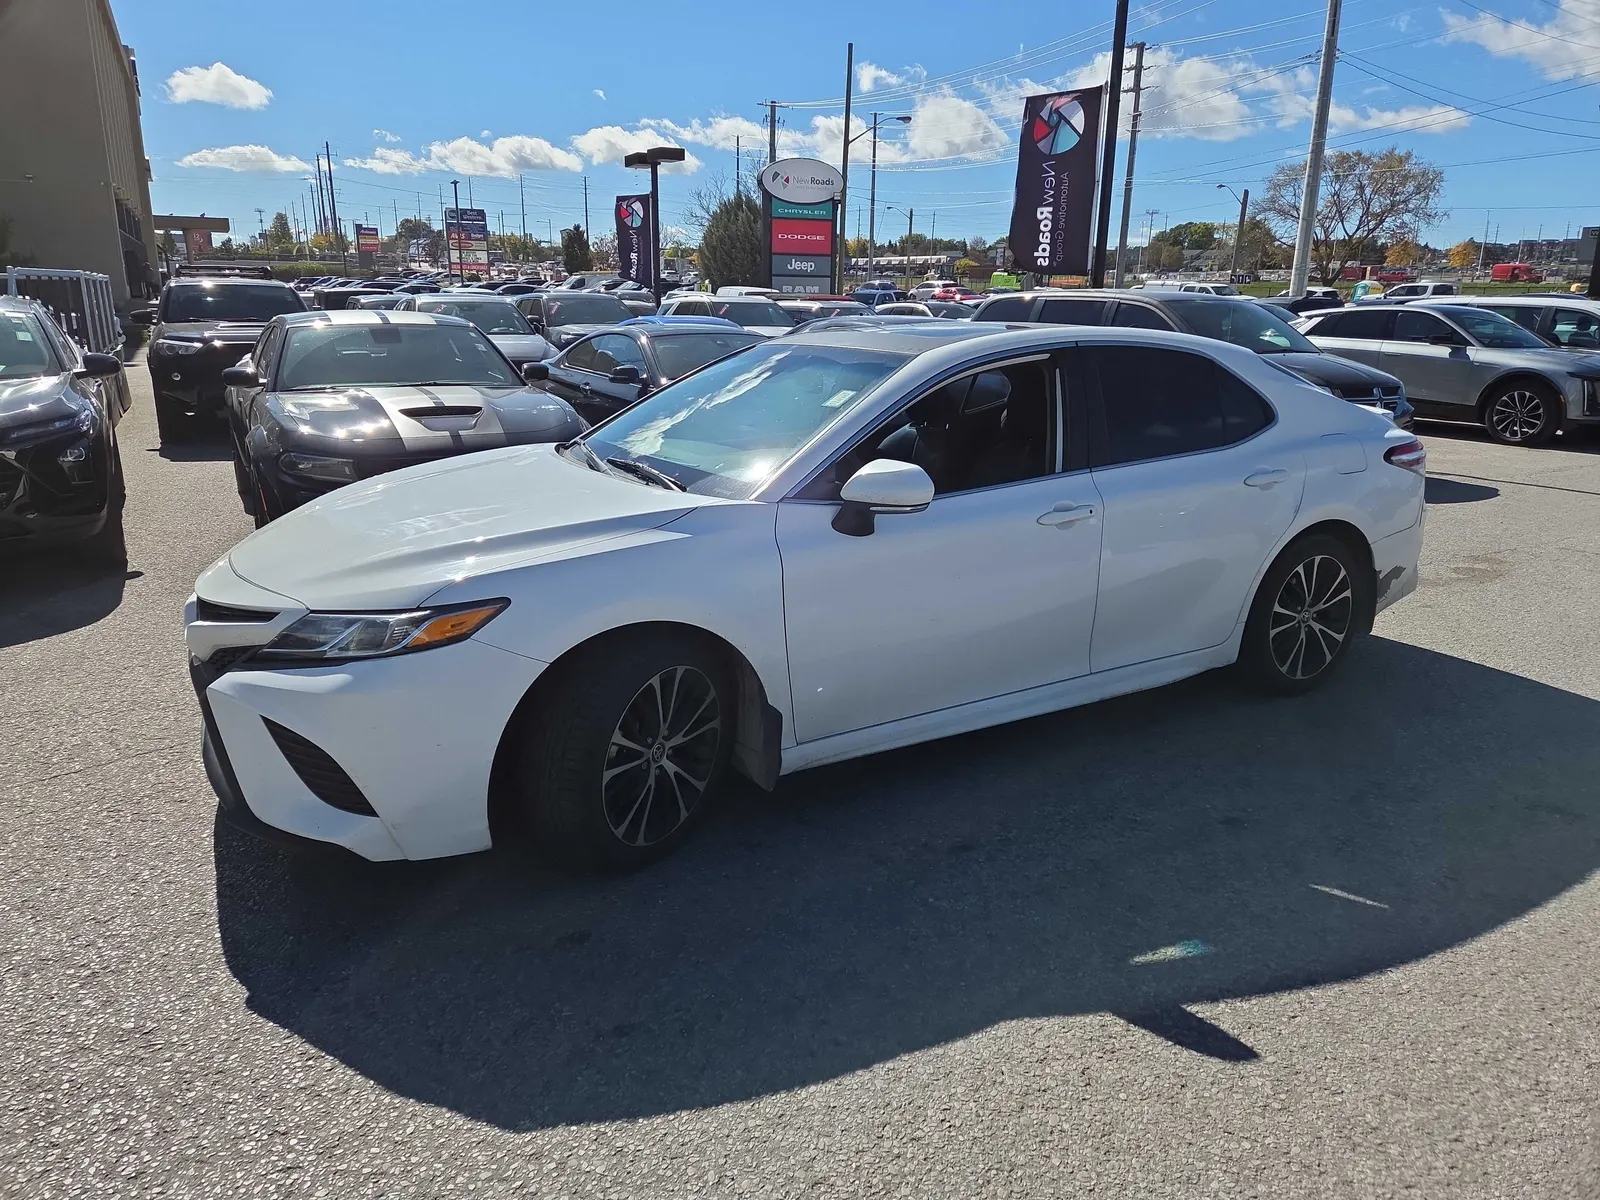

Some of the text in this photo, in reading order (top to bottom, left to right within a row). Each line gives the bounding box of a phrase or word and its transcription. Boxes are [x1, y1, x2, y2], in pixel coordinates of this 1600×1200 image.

[778, 233, 826, 241] DODGE
[787, 258, 815, 273] Jeep
[782, 285, 820, 293] RAM
